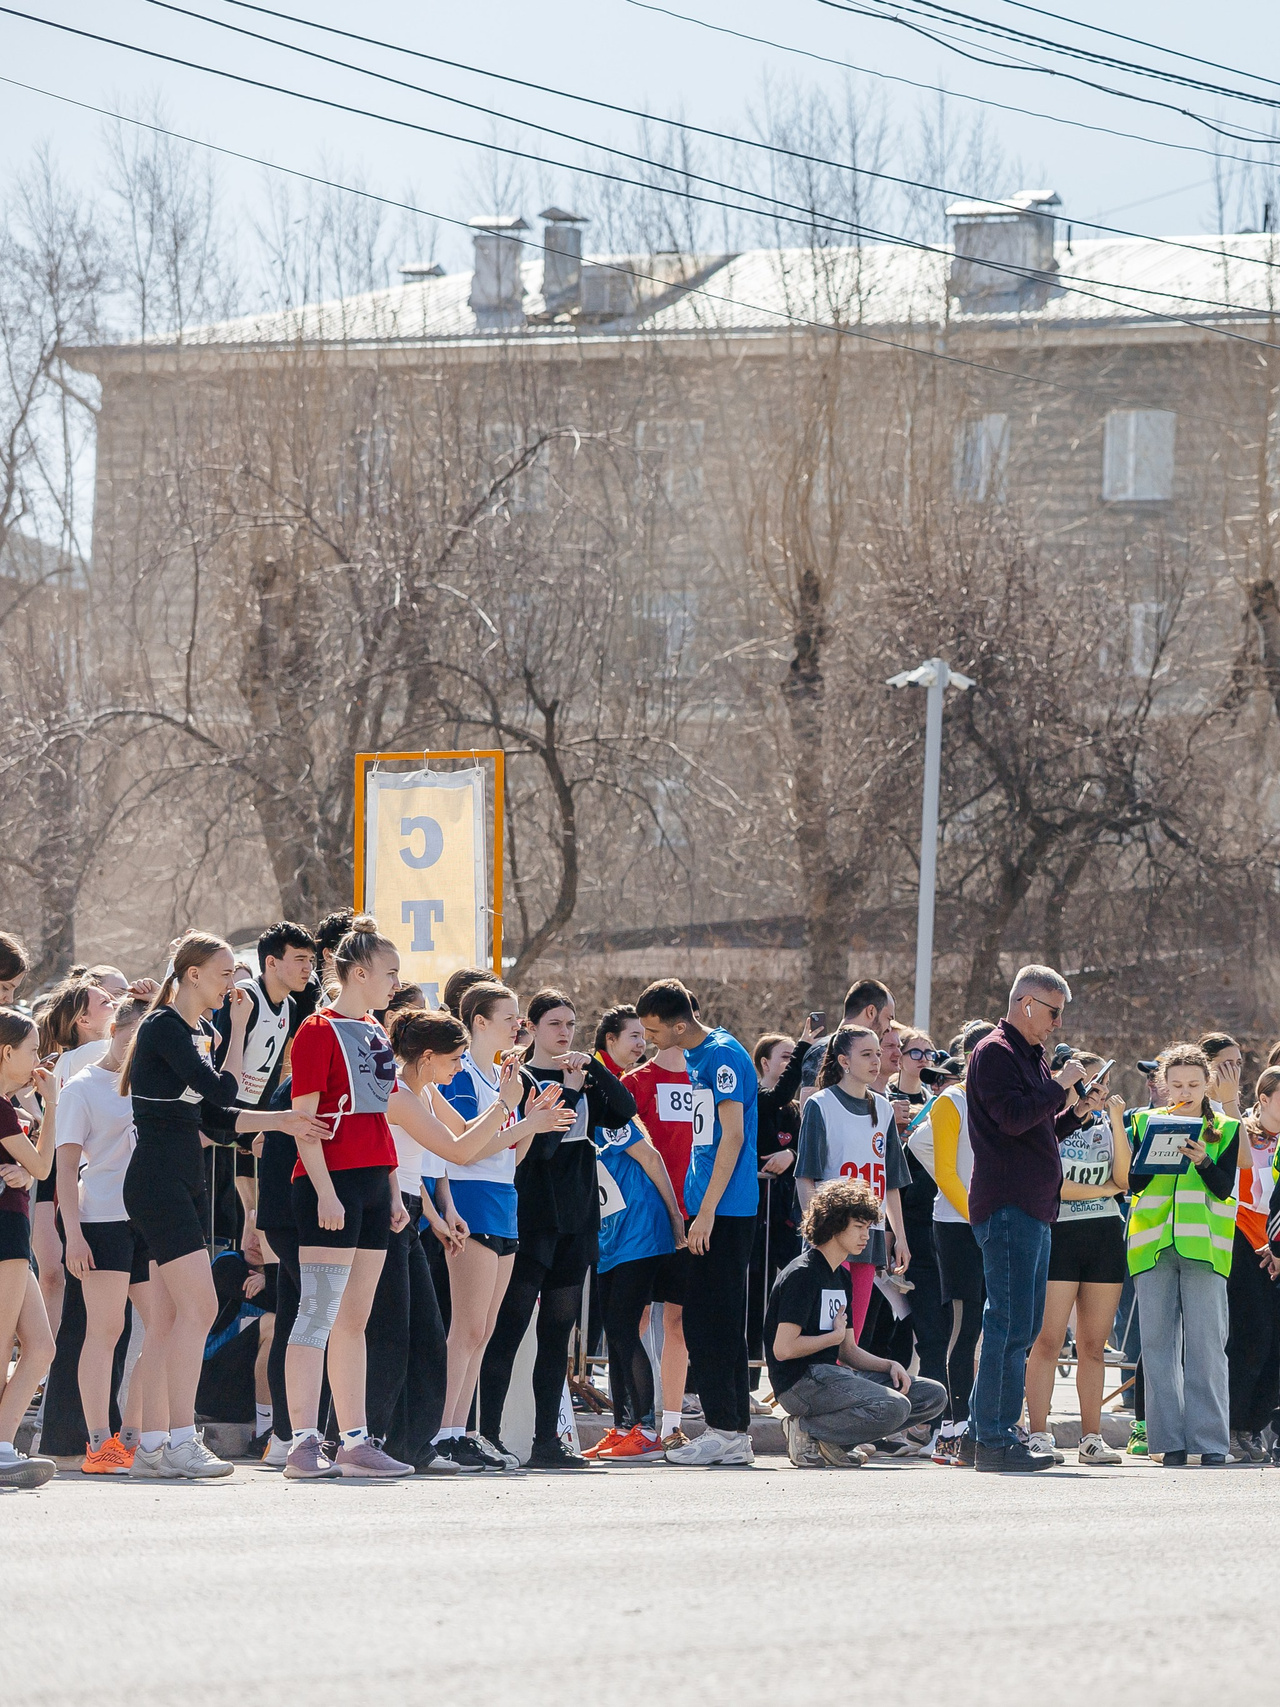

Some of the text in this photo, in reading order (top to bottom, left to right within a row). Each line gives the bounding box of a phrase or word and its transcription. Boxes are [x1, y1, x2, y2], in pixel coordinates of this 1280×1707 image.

[256, 1035, 275, 1073] 2
[670, 1091, 692, 1112] 89
[693, 1101, 704, 1134] 6
[1167, 1137, 1173, 1145] 1
[1150, 1150, 1179, 1158] этап
[1071, 1203, 1105, 1213] ОБЛАСТЬ
